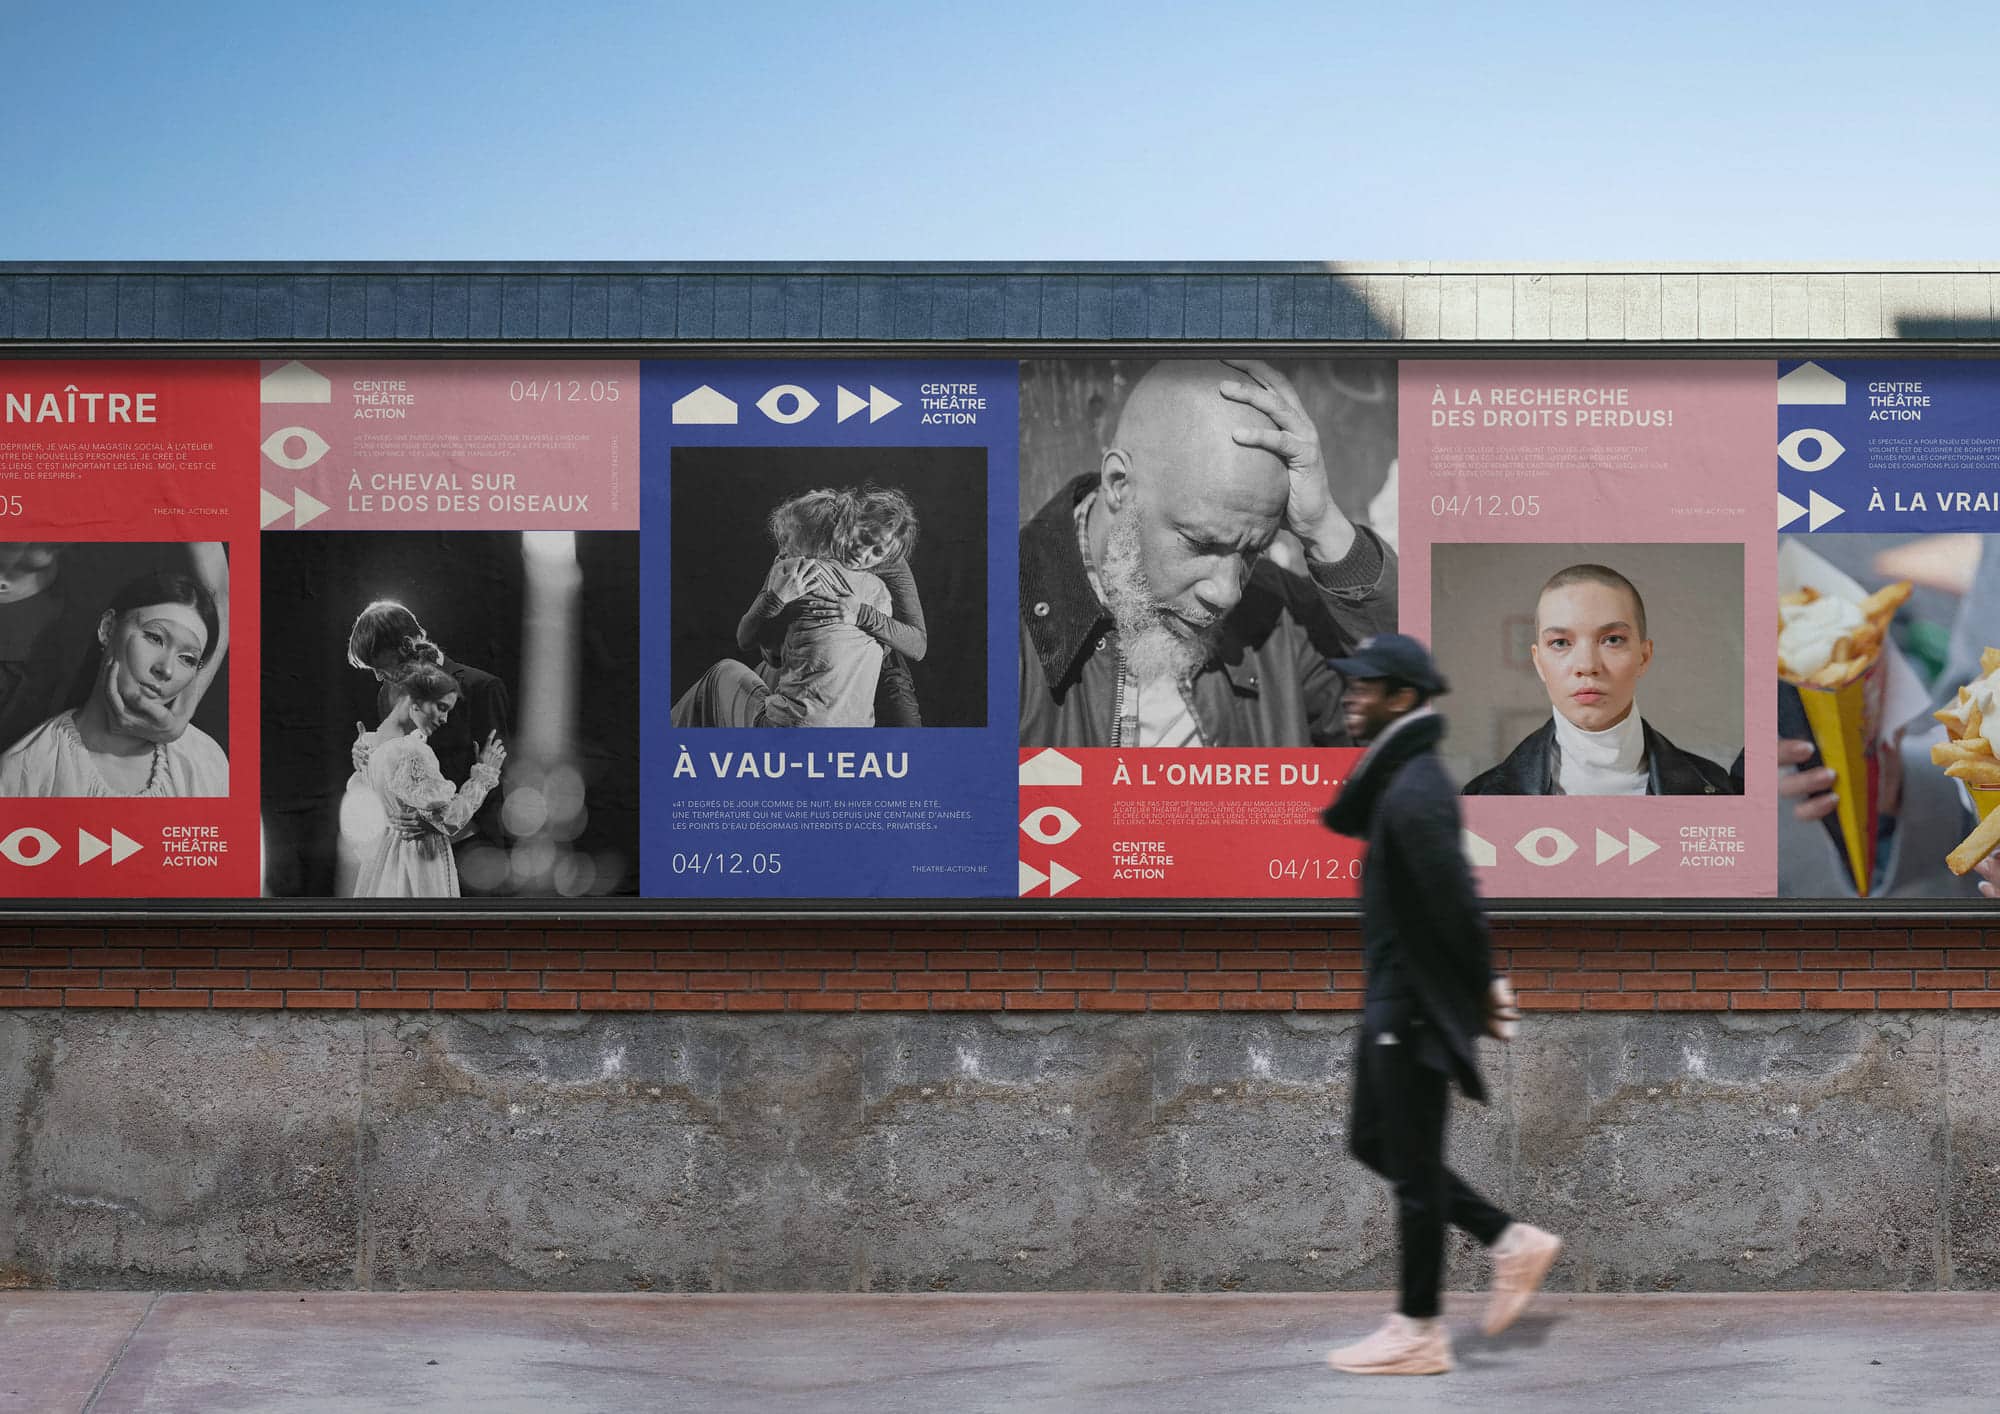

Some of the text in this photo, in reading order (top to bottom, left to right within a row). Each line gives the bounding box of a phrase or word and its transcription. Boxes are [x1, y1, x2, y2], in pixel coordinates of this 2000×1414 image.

[353, 381, 406, 390] CENTRE
[511, 381, 619, 401] 04/12.05
[921, 384, 977, 394] CENTRE
[1869, 383, 1922, 392] CENTRE
[354, 390, 414, 404] THÉÂTRE
[1432, 384, 1628, 405] À LA RECHERCHE
[1869, 393, 1930, 406] THÉÂTRE
[7, 385, 156, 422] NAÎTRE
[921, 395, 986, 409] THÉÂTRE
[354, 408, 405, 418] ACTION
[922, 413, 976, 424] ACTION
[1432, 410, 1672, 426] DES DROITS PERDUS!
[1870, 410, 1920, 420] ACTION
[47, 442, 56, 450] JE
[58, 442, 76, 450] VAIS
[79, 442, 89, 450] AU
[93, 442, 132, 450] MAGASIN
[134, 442, 163, 450] SOCIAL
[349, 469, 515, 490] À CHEVAL SUR
[349, 495, 588, 512] LE DOS DES OISEAUX
[1868, 487, 1998, 511] À LA VRAI
[1432, 496, 1539, 515] 04/12.05
[673, 745, 907, 778] À VAU-L'EAU
[1113, 758, 1131, 785] À
[723, 800, 734, 808] DE
[737, 800, 758, 808] JOUR
[761, 800, 794, 808] COMME
[797, 800, 808, 808] DE
[834, 800, 845, 808] EN
[848, 800, 872, 808] HIVER
[874, 800, 907, 808] COMME
[910, 800, 921, 808] EN
[672, 811, 689, 819] UNE
[692, 811, 751, 819] TEMPÉRATURE
[753, 811, 768, 819] QUI
[771, 811, 783, 819] NE
[785, 811, 808, 819] VARIE
[811, 811, 830, 819] PLUS
[832, 811, 862, 819] DEPUIS
[864, 811, 881, 819] UNE
[884, 811, 926, 819] CENTAINE
[163, 827, 218, 837] CENTRE
[672, 822, 687, 830] LES
[689, 822, 719, 830] POINTS
[801, 822, 843, 830] INTERDITS
[1680, 827, 1736, 837] CENTRE
[162, 838, 227, 852] THÉÂTRE
[1113, 842, 1165, 852] CENTRE
[1680, 838, 1744, 852] THÉÂTRE
[163, 856, 217, 866] ACTION
[673, 853, 780, 873] 04/12.05
[1113, 853, 1173, 865] THÉÂTRE
[1680, 856, 1734, 866] ACTION
[1114, 869, 1164, 879] ACTION
[1269, 859, 1362, 879] 04/12.0
